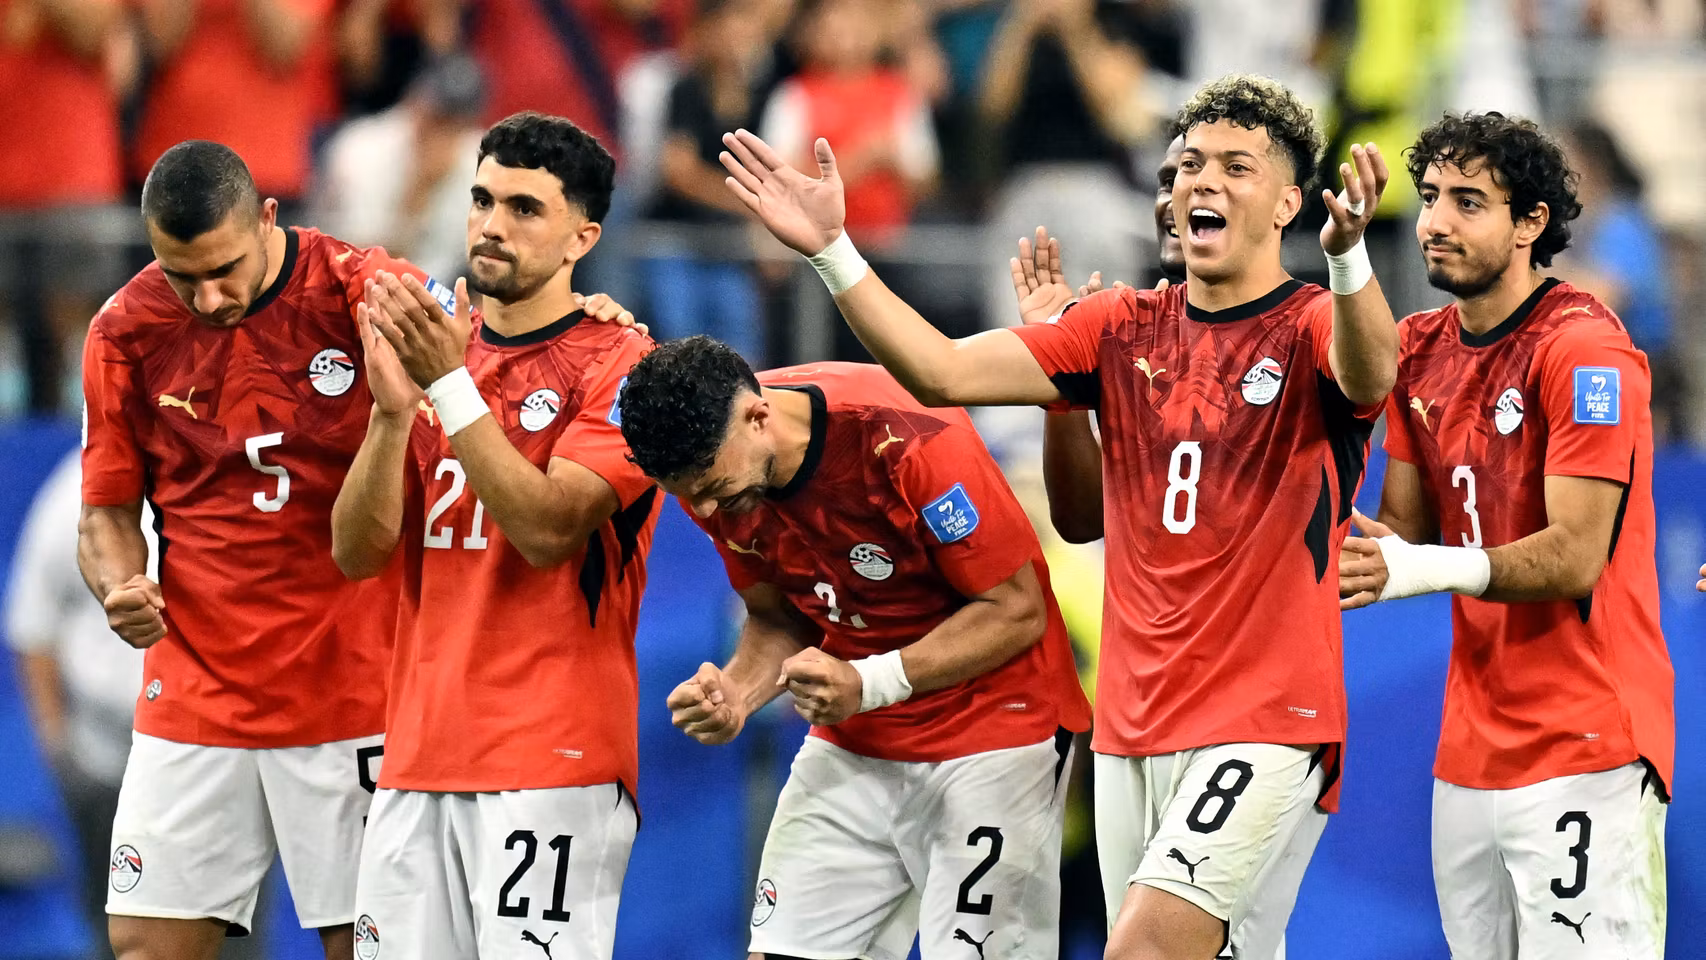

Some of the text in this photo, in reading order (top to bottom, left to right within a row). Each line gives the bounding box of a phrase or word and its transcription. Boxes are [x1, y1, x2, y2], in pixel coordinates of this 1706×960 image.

[1586, 402, 1609, 412] PEACE
[245, 431, 290, 513] 5
[423, 458, 488, 550] 21
[1162, 441, 1202, 534] 8
[1452, 465, 1483, 548] 3
[945, 515, 969, 534] PEACE
[1185, 758, 1255, 835] 8
[497, 829, 575, 922] 21
[955, 825, 1004, 915] 2
[1550, 810, 1592, 899] 3
